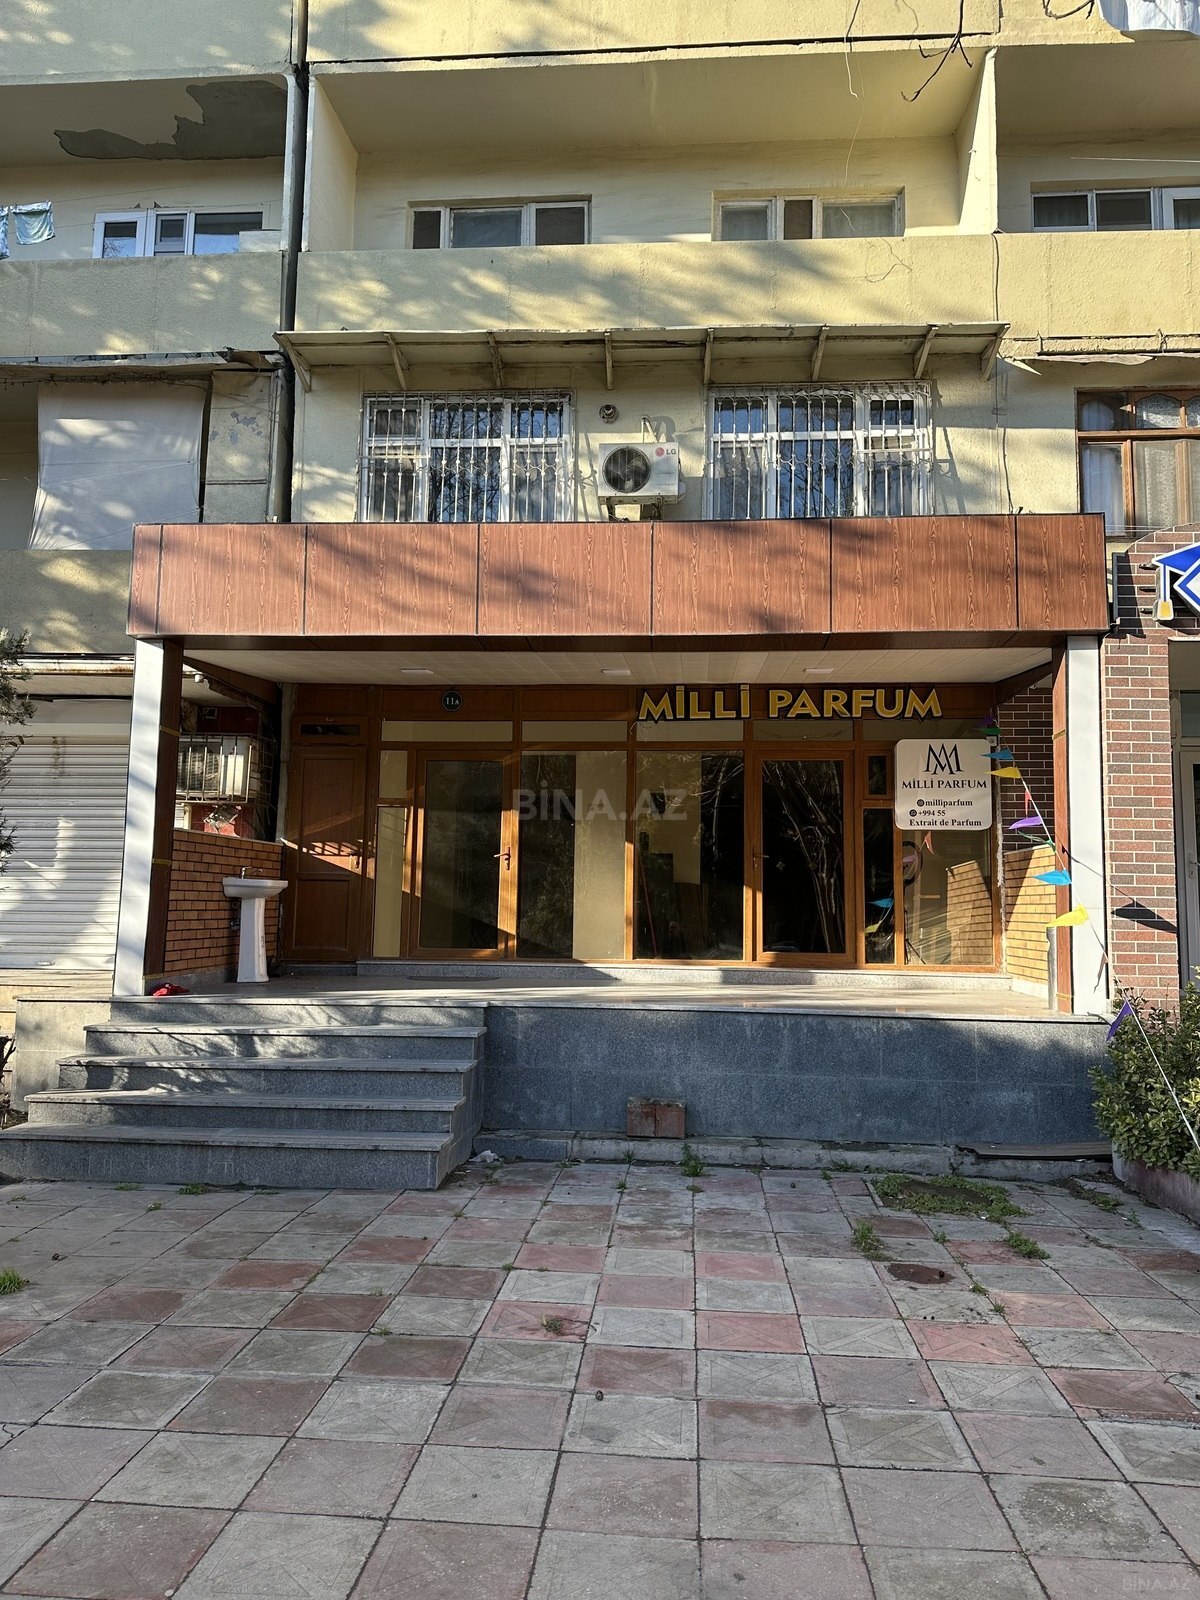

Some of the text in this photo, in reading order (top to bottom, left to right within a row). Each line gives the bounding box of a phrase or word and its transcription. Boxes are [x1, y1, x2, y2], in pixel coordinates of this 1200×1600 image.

[638, 685, 943, 722] MİLLİ PARFUM
[902, 778, 987, 789] MİLLİ PARFUM
[925, 799, 973, 808] milliparfum
[909, 819, 982, 827] Extrait de Parfum
